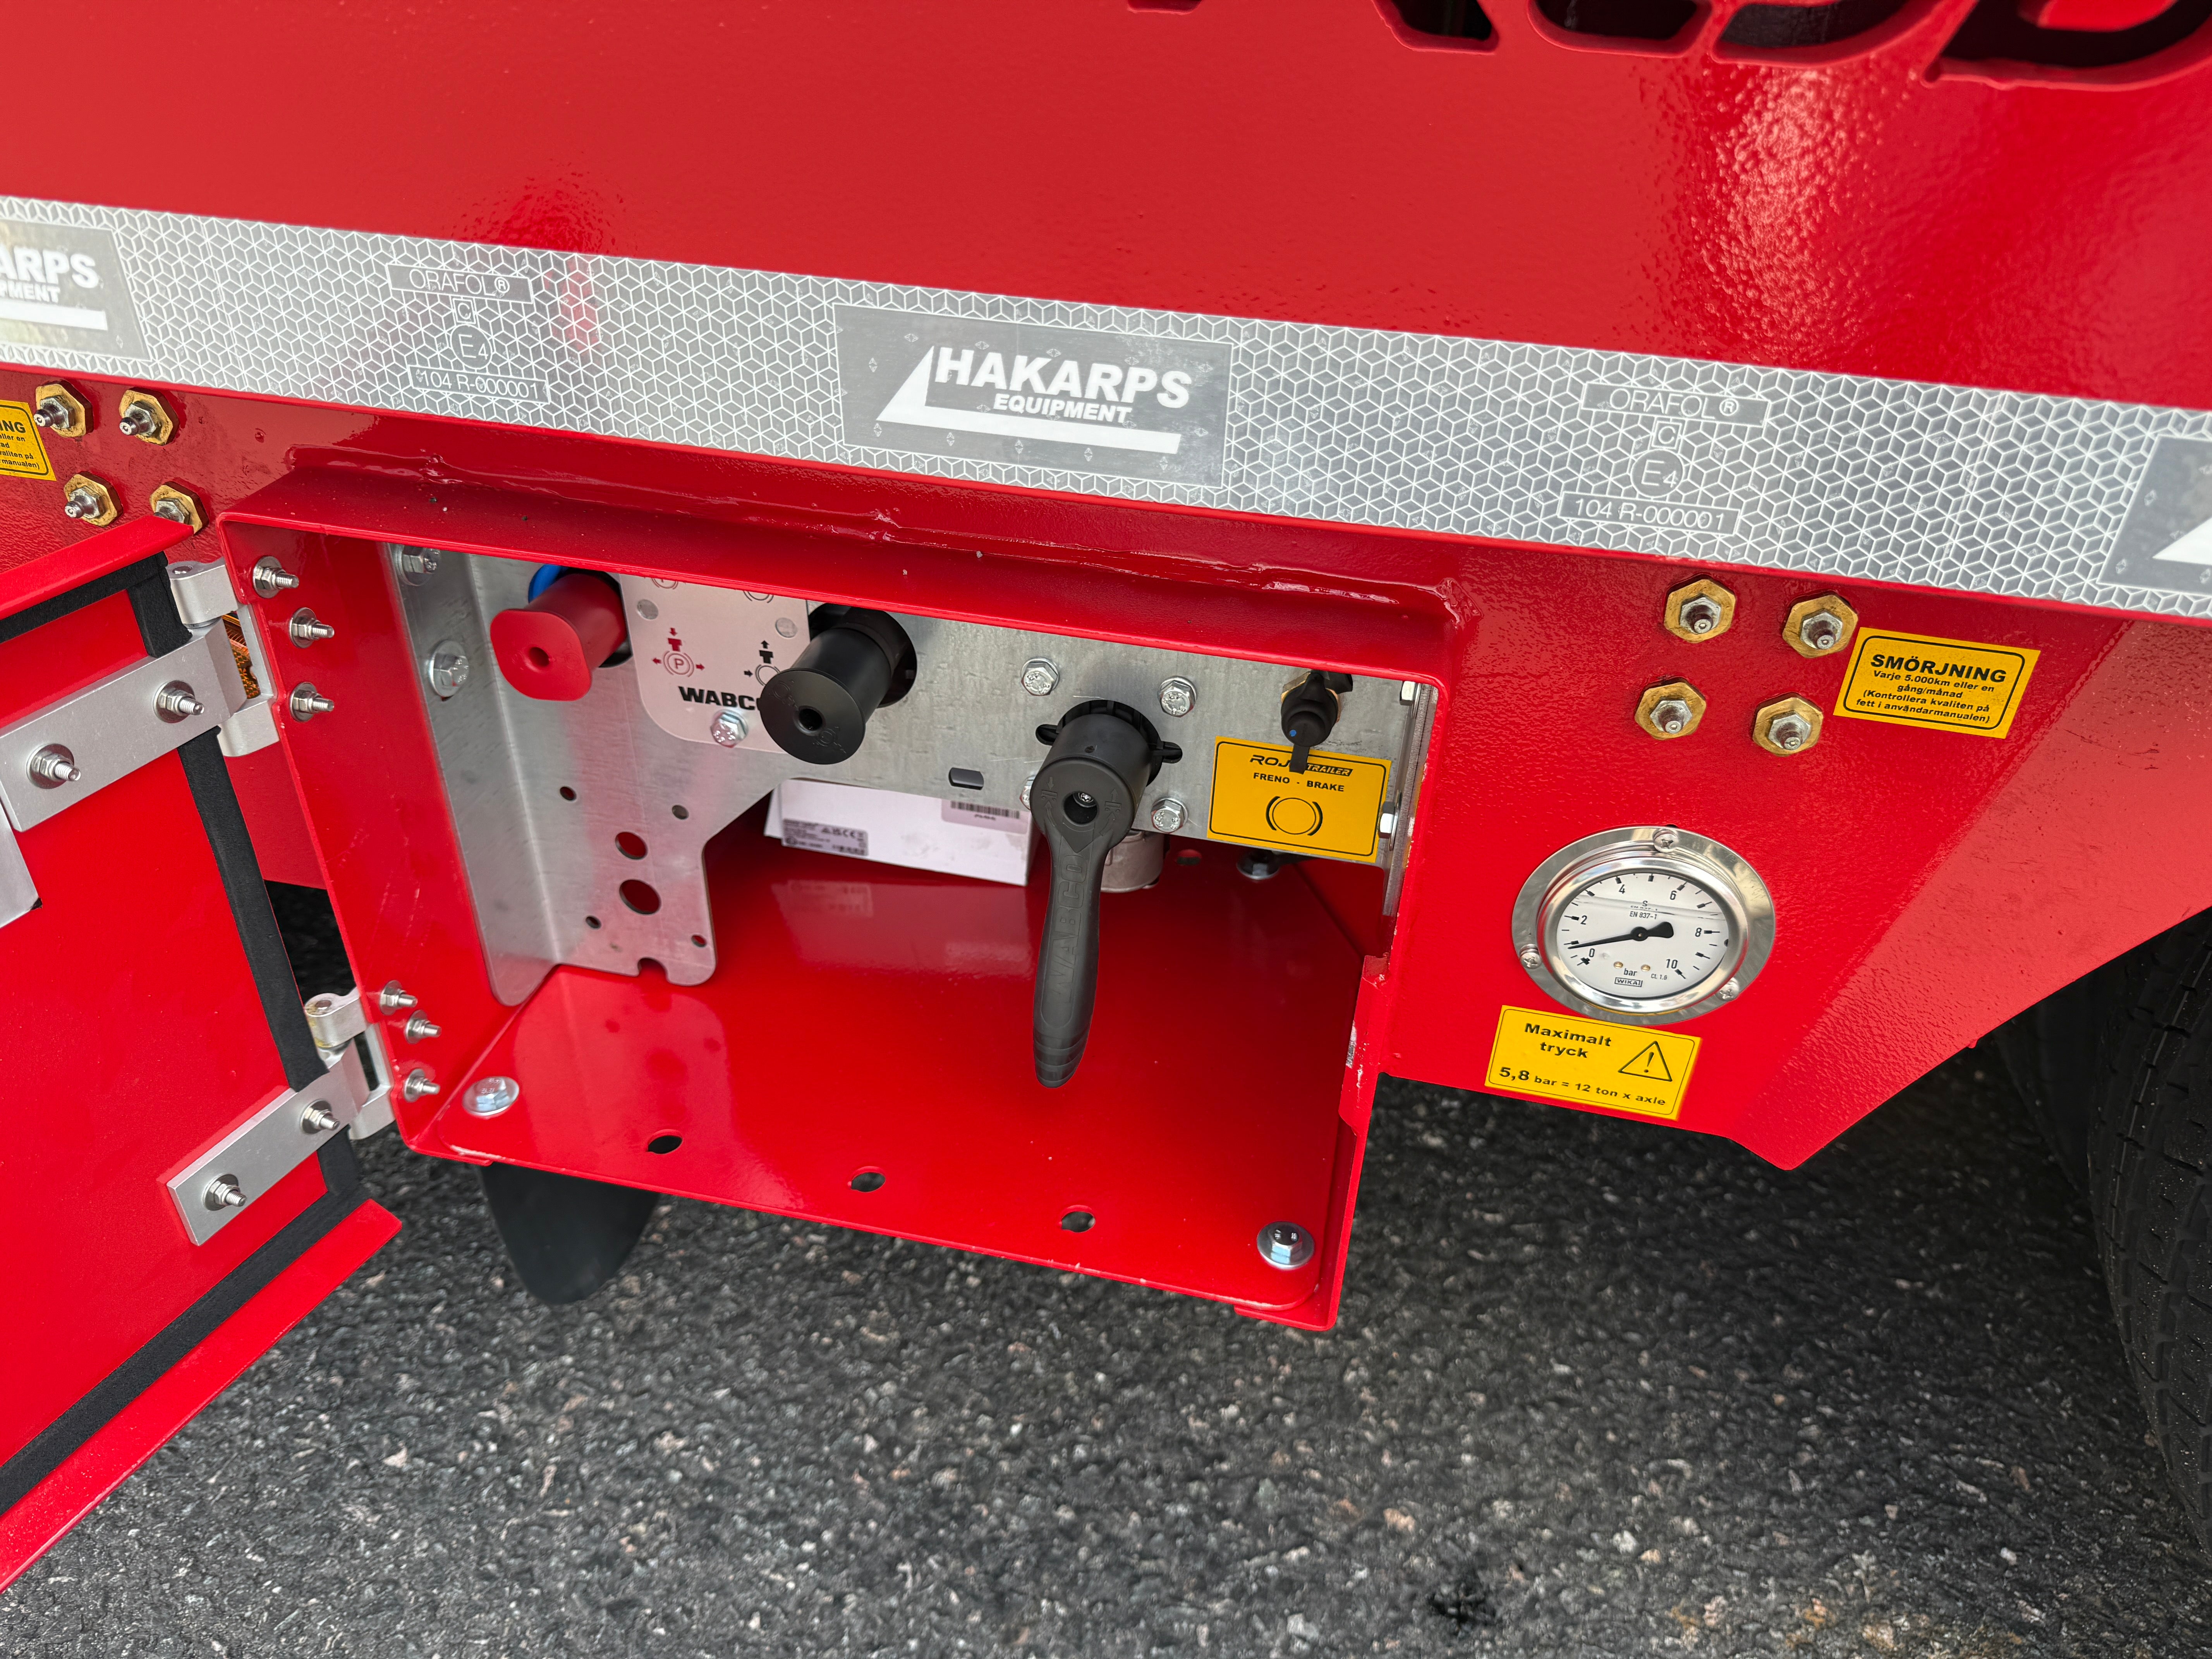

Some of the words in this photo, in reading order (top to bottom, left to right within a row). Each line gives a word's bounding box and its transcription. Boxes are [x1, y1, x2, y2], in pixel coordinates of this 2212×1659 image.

[421, 371, 452, 389] 104
[456, 374, 538, 399] R-000001
[935, 347, 1192, 408] HAKARPS
[993, 393, 1132, 423] EQUIPMENT
[1576, 499, 1612, 517] 104
[1619, 503, 1724, 531] R-000001
[1870, 654, 2006, 683] SMÖRJNING
[1874, 670, 1901, 680] Varje
[1905, 675, 1950, 686] 5.000km
[1954, 682, 1978, 690] eller
[1897, 684, 1963, 698] gång/månad
[678, 686, 761, 711] WABC
[1863, 690, 1927, 704] (Kontrollera
[1930, 698, 1973, 710] kvaliten
[1976, 704, 1990, 713] på
[1856, 699, 1875, 707] fett
[1884, 705, 1990, 724] användarmanualen)
[1250, 754, 1291, 768] ROJ
[1307, 764, 1350, 776] TRAILER
[1253, 772, 1290, 784] FRENO
[1307, 780, 1345, 792] BRAKE
[1618, 884, 1625, 894] 4
[1669, 890, 1677, 900] 6
[1048, 854, 1087, 1004] WABCO
[1580, 915, 1587, 925] 2
[1695, 927, 1702, 937] 8
[1589, 948, 1595, 957] 0
[1666, 958, 1678, 969] 10
[1623, 968, 1637, 976] bar
[1524, 1023, 1611, 1046] Maximalt
[1540, 1042, 1588, 1058] tryck
[1499, 1066, 1530, 1081] 5,8
[1534, 1075, 1557, 1086] bar
[1575, 1083, 1591, 1092] 12
[1595, 1087, 1618, 1097] ton
[1635, 1097, 1666, 1105] axle
